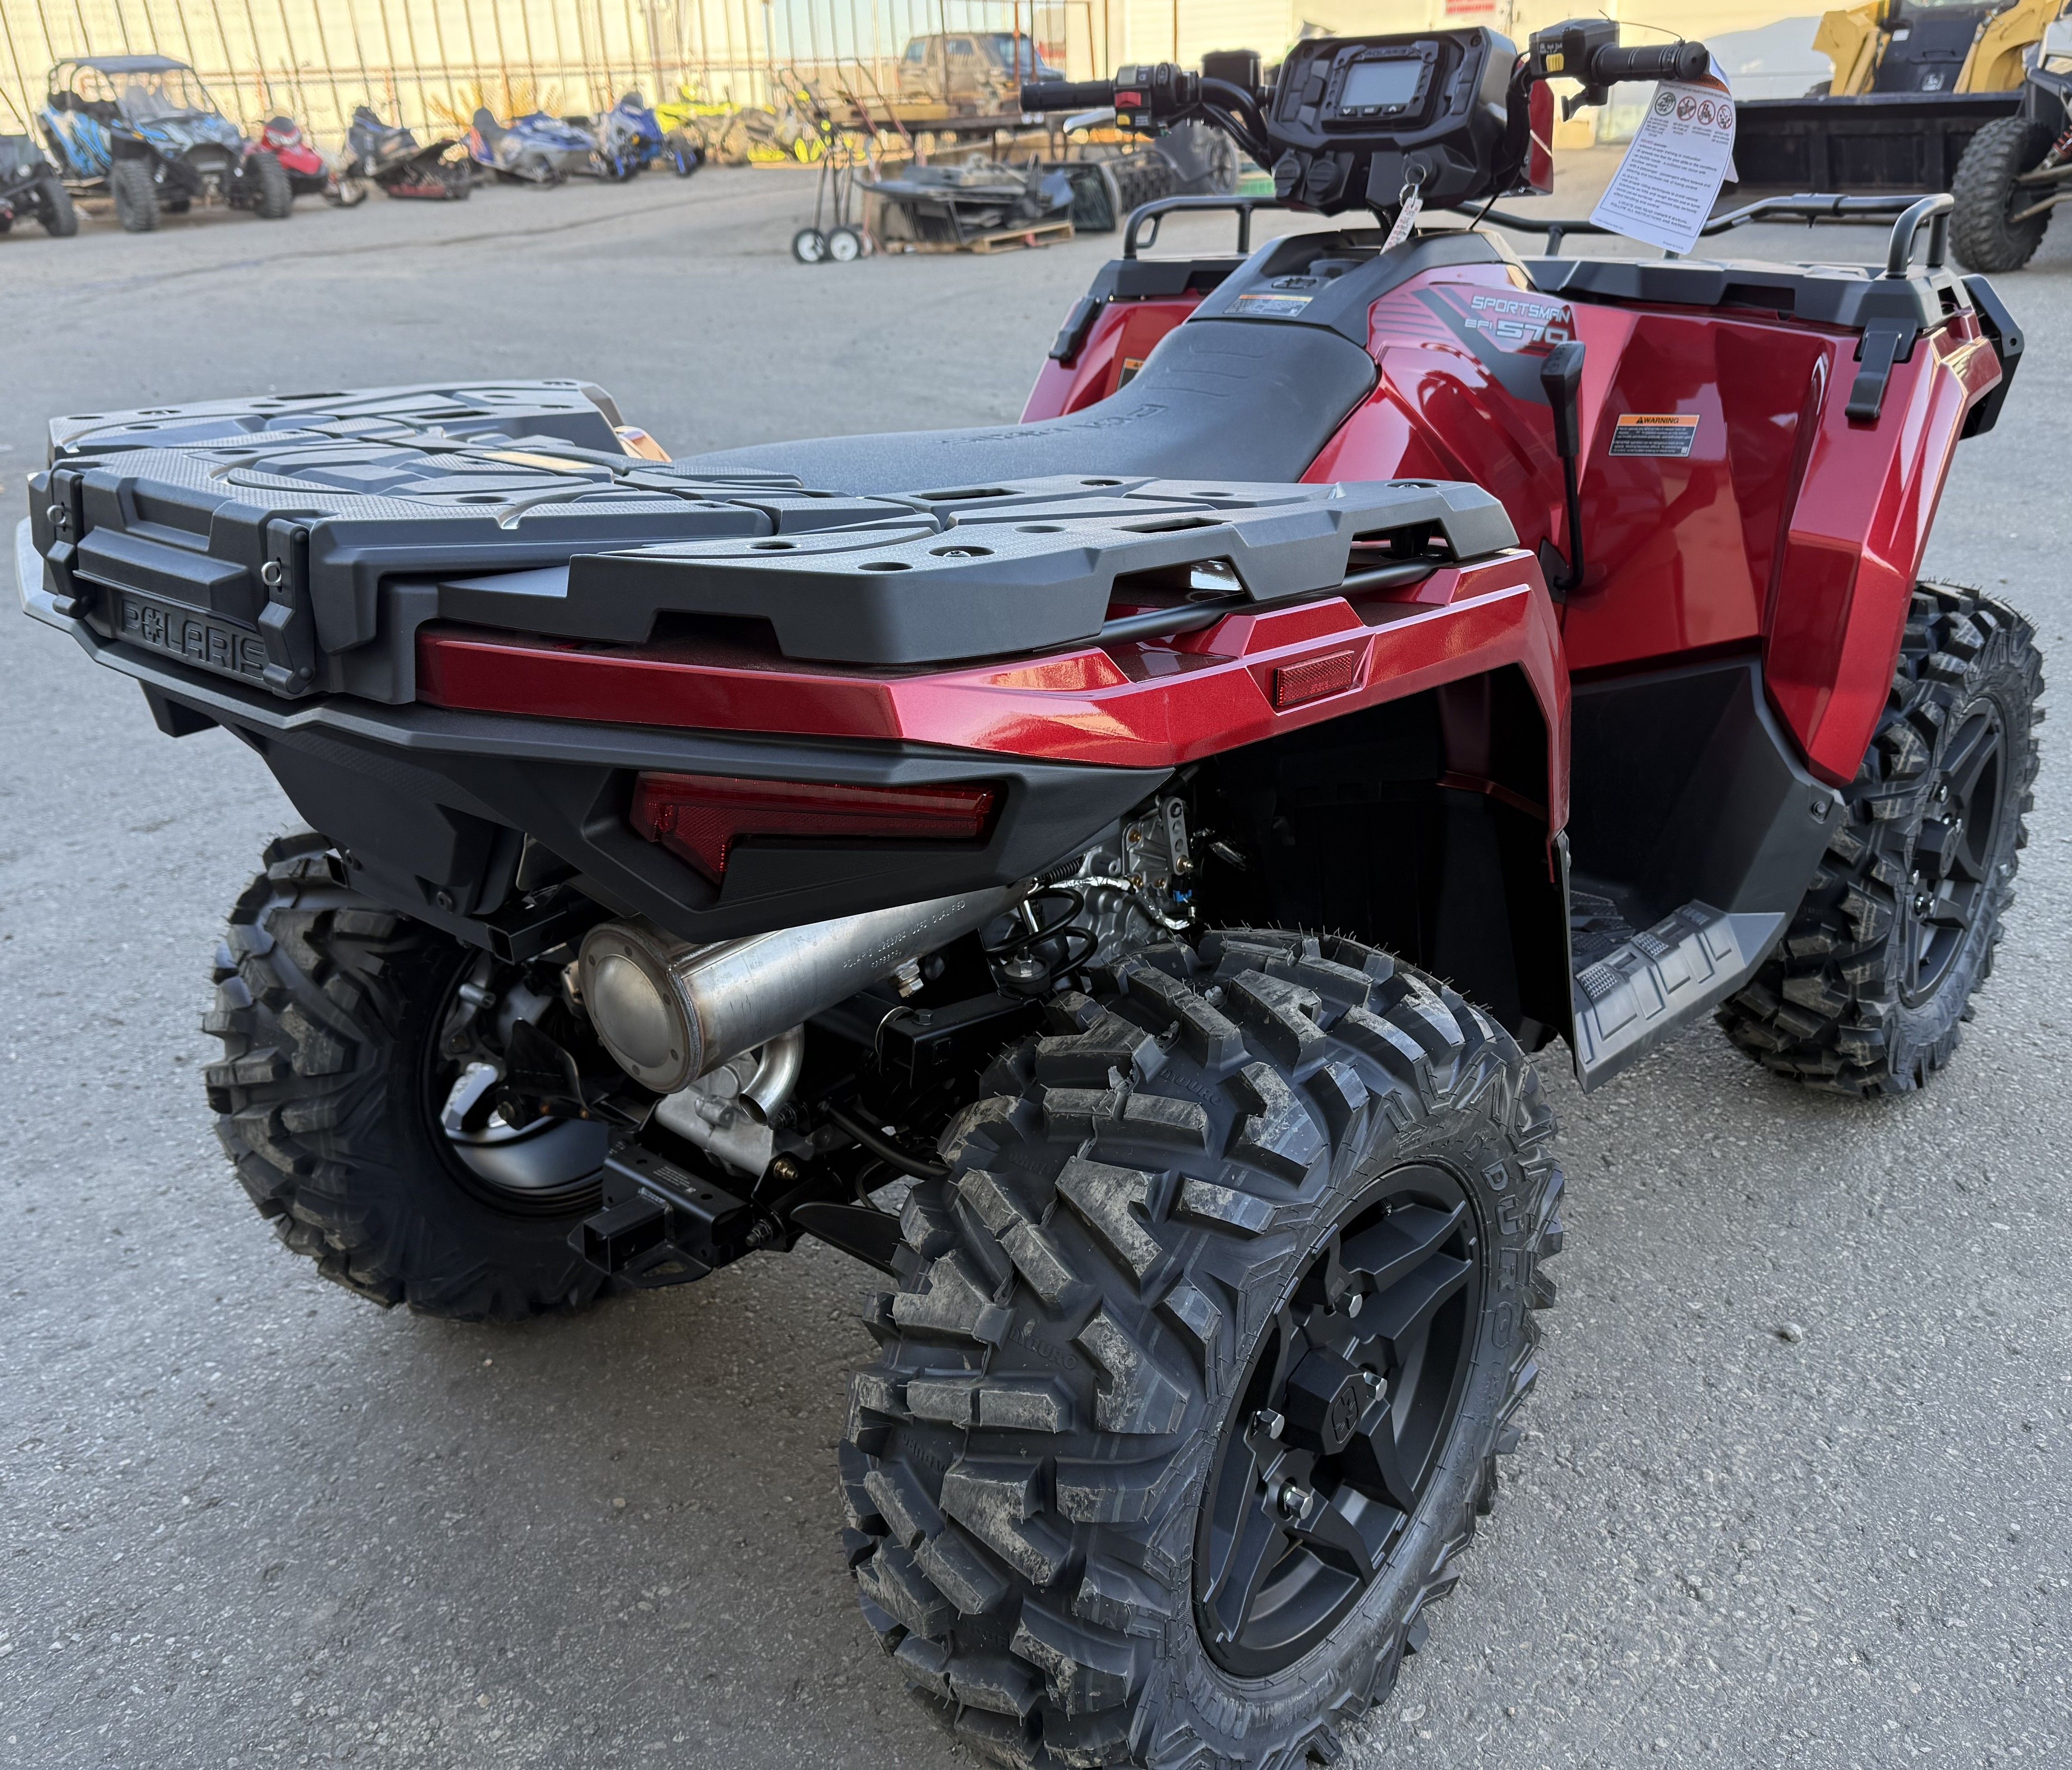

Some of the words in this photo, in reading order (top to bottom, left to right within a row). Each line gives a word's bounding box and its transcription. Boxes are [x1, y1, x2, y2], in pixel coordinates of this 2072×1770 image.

[1471, 295, 1570, 324] SPORTSMAN
[1465, 319, 1492, 330] EFI
[1496, 320, 1569, 344] 570
[1482, 1158, 1519, 1349] DURO
